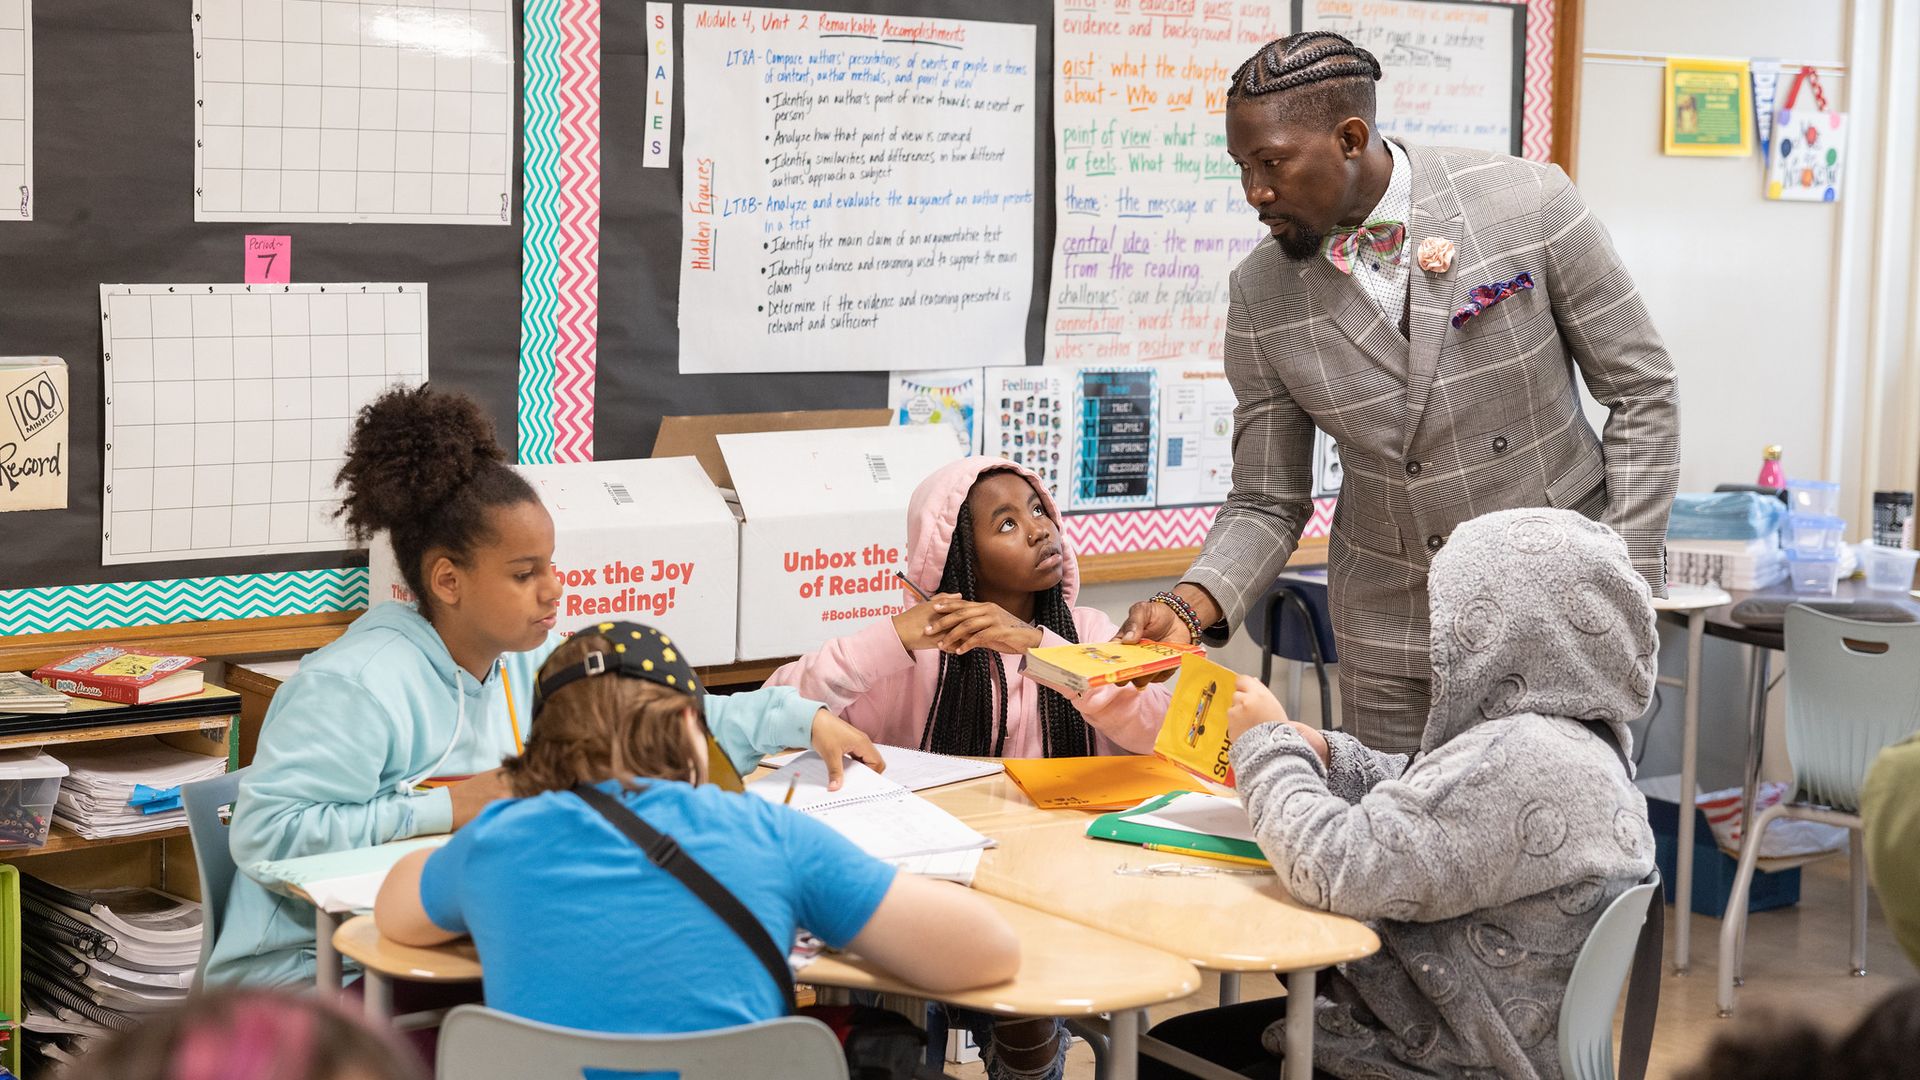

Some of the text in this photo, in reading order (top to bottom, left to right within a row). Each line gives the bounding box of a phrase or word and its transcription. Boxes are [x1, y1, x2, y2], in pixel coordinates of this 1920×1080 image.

[697, 11, 966, 44] Module 4, Unit 2 Remarkable Accomplishments
[1062, 13, 1233, 48] evidence and background
[766, 49, 802, 68] Compare
[849, 52, 900, 69] presentations
[908, 53, 917, 68] of
[922, 55, 947, 71] events
[1110, 51, 1229, 88] what the chapter
[652, 16, 666, 155] SCALES
[766, 68, 774, 84] of
[777, 69, 814, 86] content,
[818, 69, 845, 82] author
[895, 72, 911, 84] and
[772, 88, 970, 114] Identify an author's point of view towards
[1126, 85, 1157, 105] Who
[1167, 86, 1192, 106] and
[775, 111, 804, 130] person
[774, 125, 922, 150] Analyze how that point of view
[1063, 118, 1196, 154] point of what
[771, 151, 811, 175] Identify
[816, 151, 865, 165] similarities
[870, 150, 884, 163] and
[888, 146, 935, 164] differences
[1066, 155, 1078, 171] or
[1128, 152, 1163, 172] What
[1172, 150, 1200, 184] they
[773, 163, 892, 188] authors approach a subject
[689, 157, 718, 270] Hidden Figures
[766, 195, 807, 216] Analyze
[813, 192, 832, 209] and
[836, 191, 880, 208] evaluate
[886, 188, 902, 206] the
[907, 189, 953, 213] argument
[956, 196, 967, 206] an
[1116, 186, 1139, 212] the
[1149, 196, 1196, 224] message
[1204, 200, 1216, 212] or
[764, 216, 811, 234] in a text
[1063, 225, 1116, 253] central
[1165, 228, 1187, 253] the
[1194, 238, 1224, 254] main
[771, 235, 814, 260] Identify
[819, 232, 833, 248] the
[838, 234, 863, 247] main
[867, 230, 891, 247] claim
[896, 229, 906, 248] of
[910, 236, 920, 246] an
[983, 225, 1002, 242] text
[257, 253, 277, 279] 7
[767, 259, 810, 285] Identify
[815, 258, 853, 276] evidence
[858, 257, 874, 271] and
[876, 257, 913, 277] reasoning
[917, 250, 935, 268] used
[938, 252, 946, 267] to
[950, 250, 979, 271] support
[983, 250, 995, 263] the
[1110, 253, 1133, 279] the
[767, 281, 793, 296] claim
[768, 287, 1000, 318] Determine if the evidence and reasoning presented
[1128, 282, 1219, 312] can be physical
[767, 312, 879, 335] relevant and sufficient
[1138, 309, 1173, 329] words
[1180, 304, 1210, 328] that
[1096, 337, 1132, 357] either
[1137, 333, 1184, 359] positive
[1189, 342, 1202, 354] or
[1002, 378, 1048, 394] Feelings!
[15, 380, 55, 427] 100
[26, 408, 58, 433] MINUTES
[0, 442, 61, 491] Record
[784, 544, 899, 573] Unbox the
[552, 559, 694, 588] box the Joy
[799, 568, 904, 599] of Readin
[567, 587, 676, 618] Reading!
[822, 605, 904, 622] #BookBoxDay
